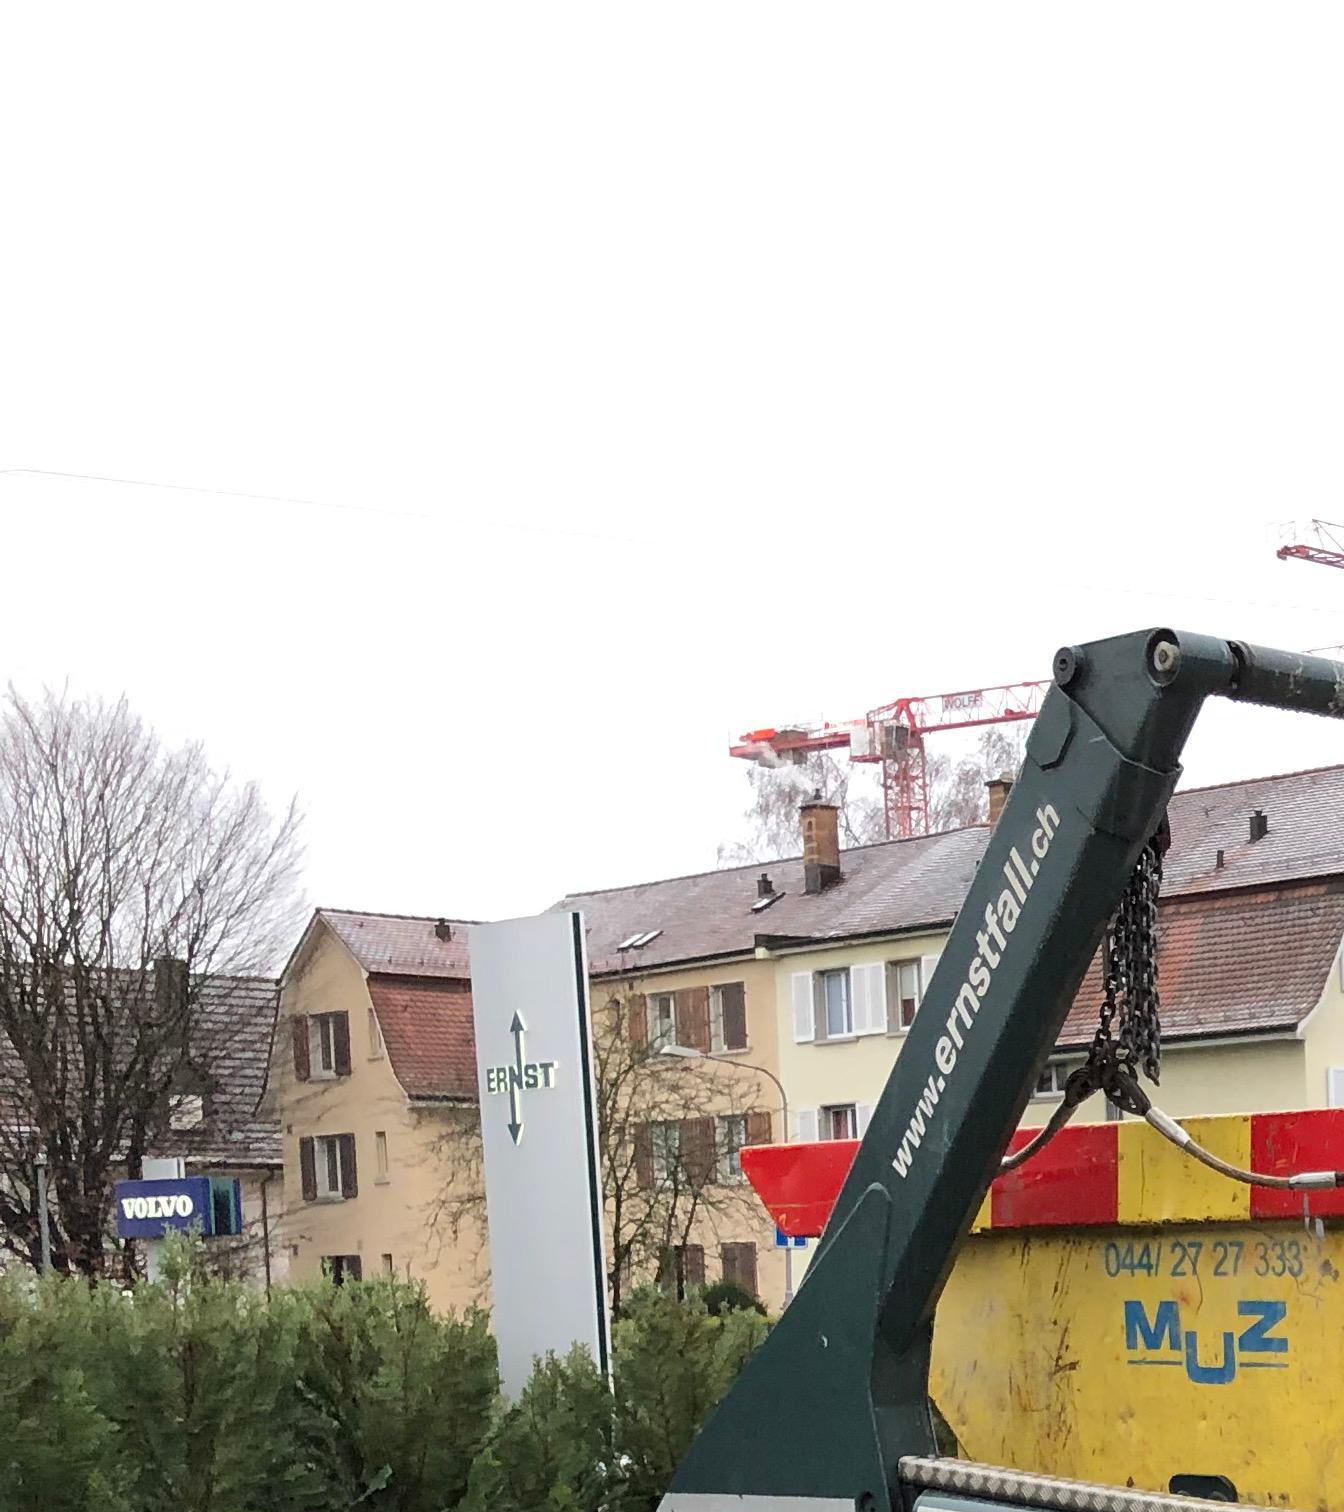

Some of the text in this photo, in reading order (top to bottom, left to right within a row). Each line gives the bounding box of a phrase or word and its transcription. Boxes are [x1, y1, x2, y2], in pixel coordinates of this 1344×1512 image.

[891, 800, 1061, 1180] www.ernstfall.ch
[486, 1061, 557, 1094] ERNST
[121, 1194, 194, 1219] VOLVO
[1170, 1240, 1204, 1278] 27
[1212, 1240, 1244, 1277] 27
[1254, 1240, 1304, 1277] 333
[1124, 1300, 1289, 1385] MUZ
